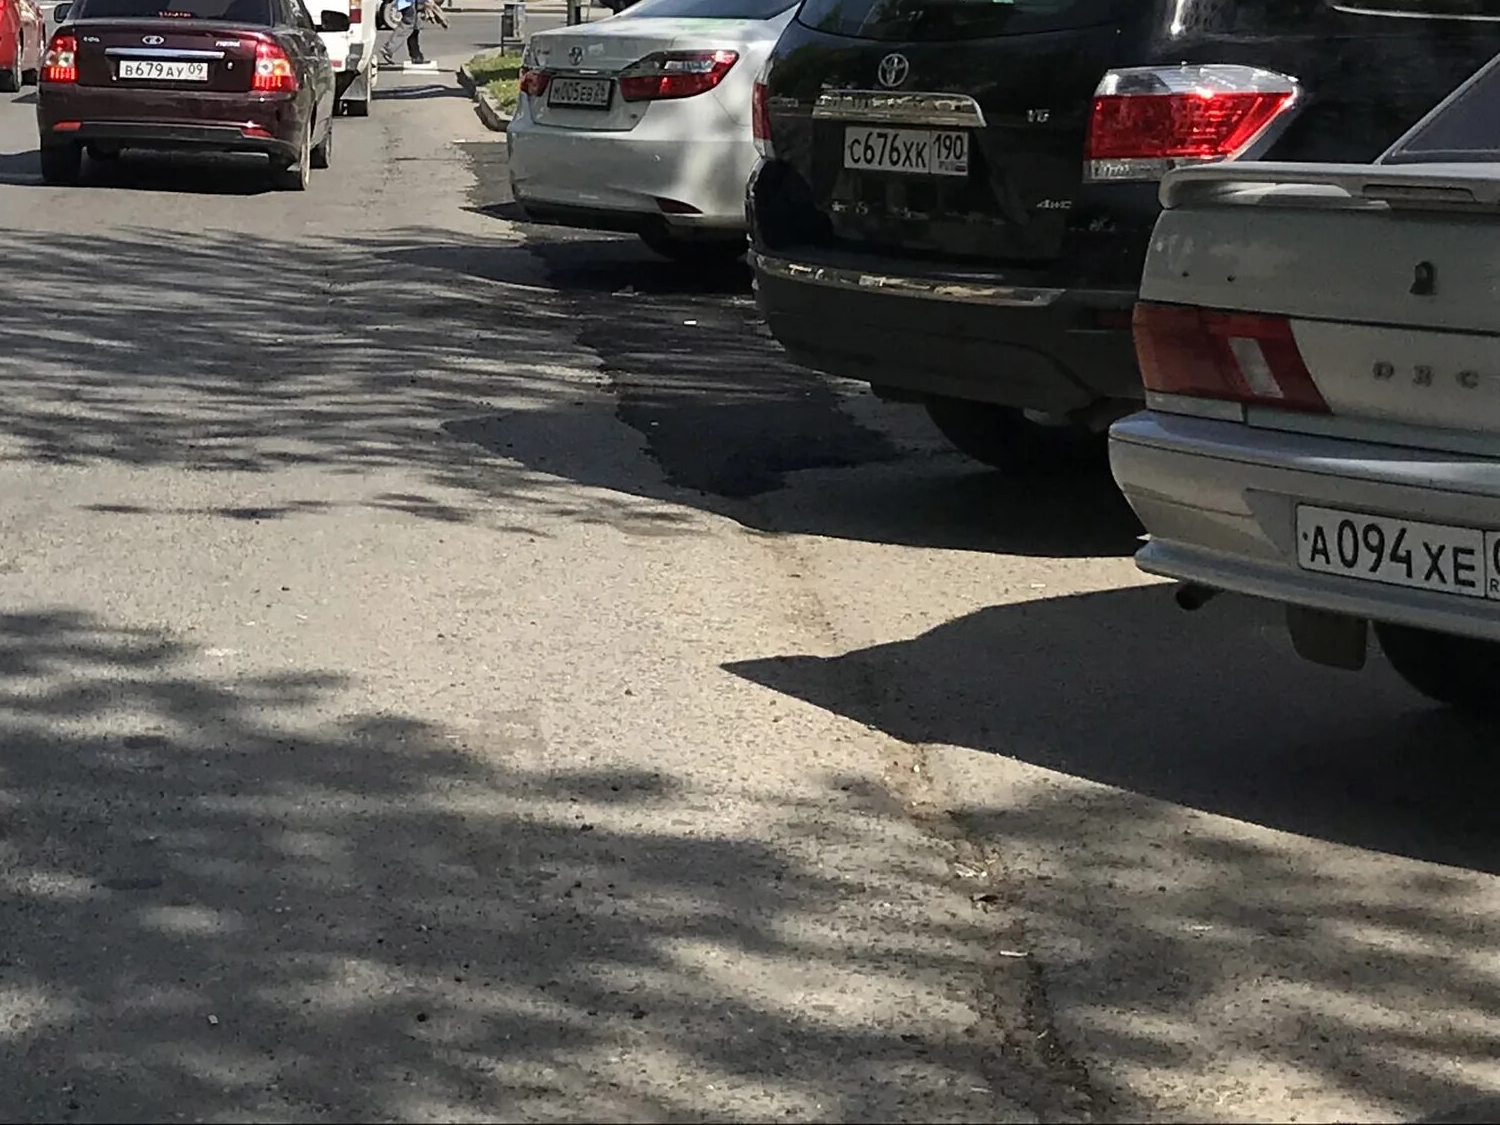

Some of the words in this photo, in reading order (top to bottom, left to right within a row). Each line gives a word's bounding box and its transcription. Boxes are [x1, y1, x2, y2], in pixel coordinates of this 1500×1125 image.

[850, 127, 927, 168] С676ХК
[933, 133, 964, 160] 190
[1309, 518, 1477, 589] А094ХЕ
